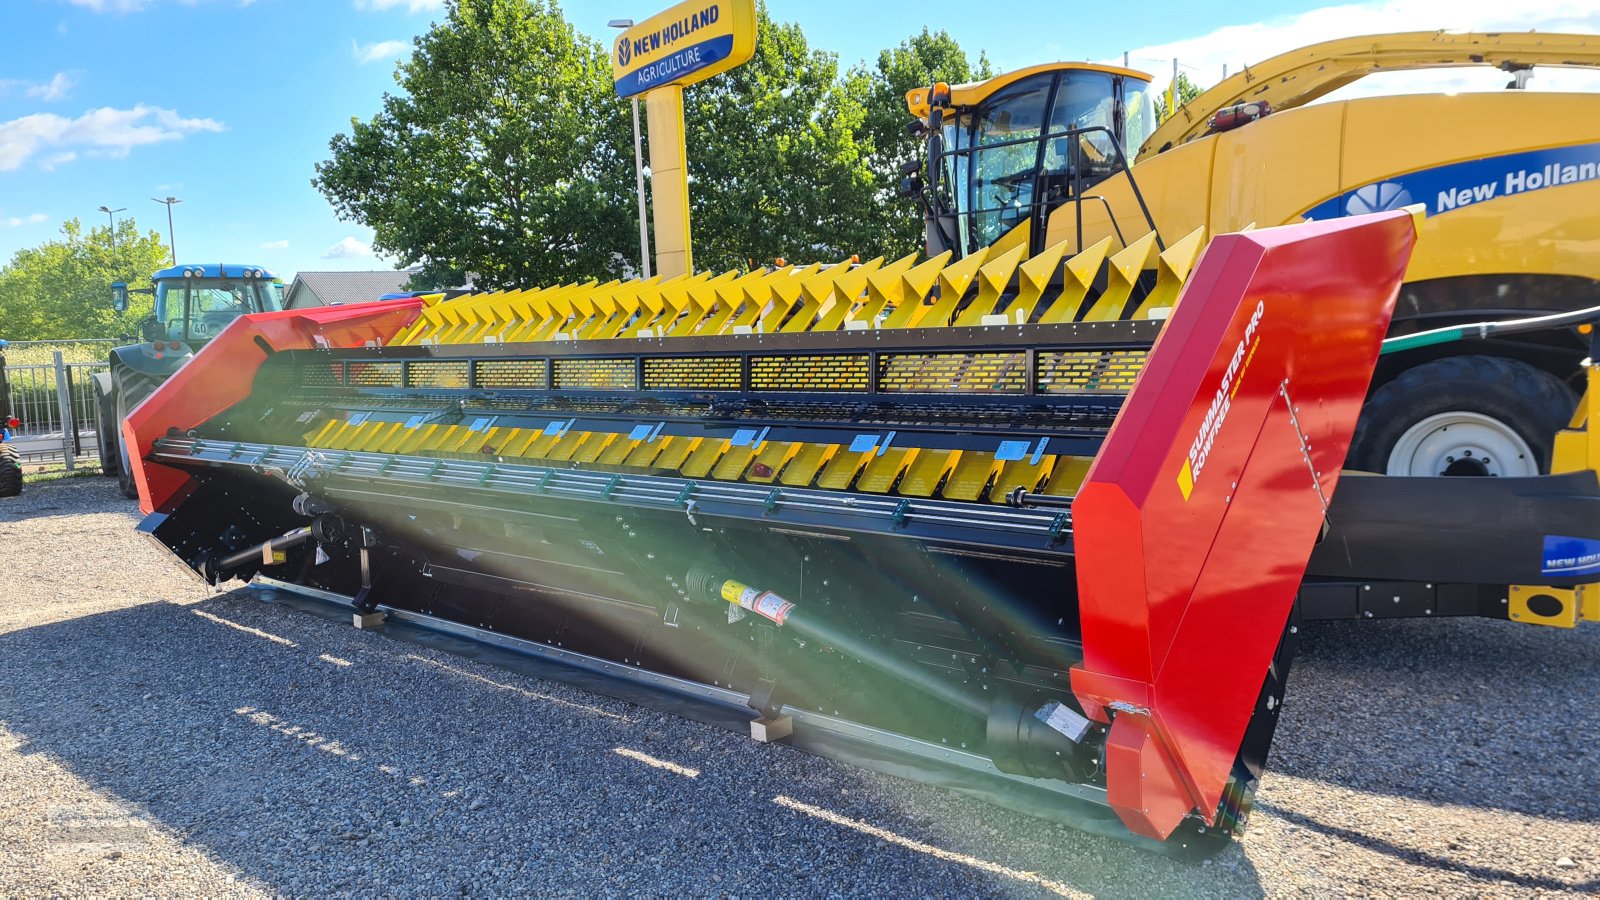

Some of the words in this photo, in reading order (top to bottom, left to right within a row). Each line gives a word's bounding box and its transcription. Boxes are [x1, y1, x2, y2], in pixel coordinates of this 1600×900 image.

[634, 31, 661, 57] NEW
[663, 4, 719, 46] HOLLAND
[637, 47, 701, 86] AGRICULTURE
[1437, 182, 1497, 213] New
[1505, 162, 1600, 194] Hollan
[195, 323, 206, 334] 40
[1189, 340, 1246, 466] SUNMASTER
[1244, 299, 1265, 346] PRO
[1192, 394, 1231, 483] ROWFREE
[1546, 557, 1576, 568] NEW
